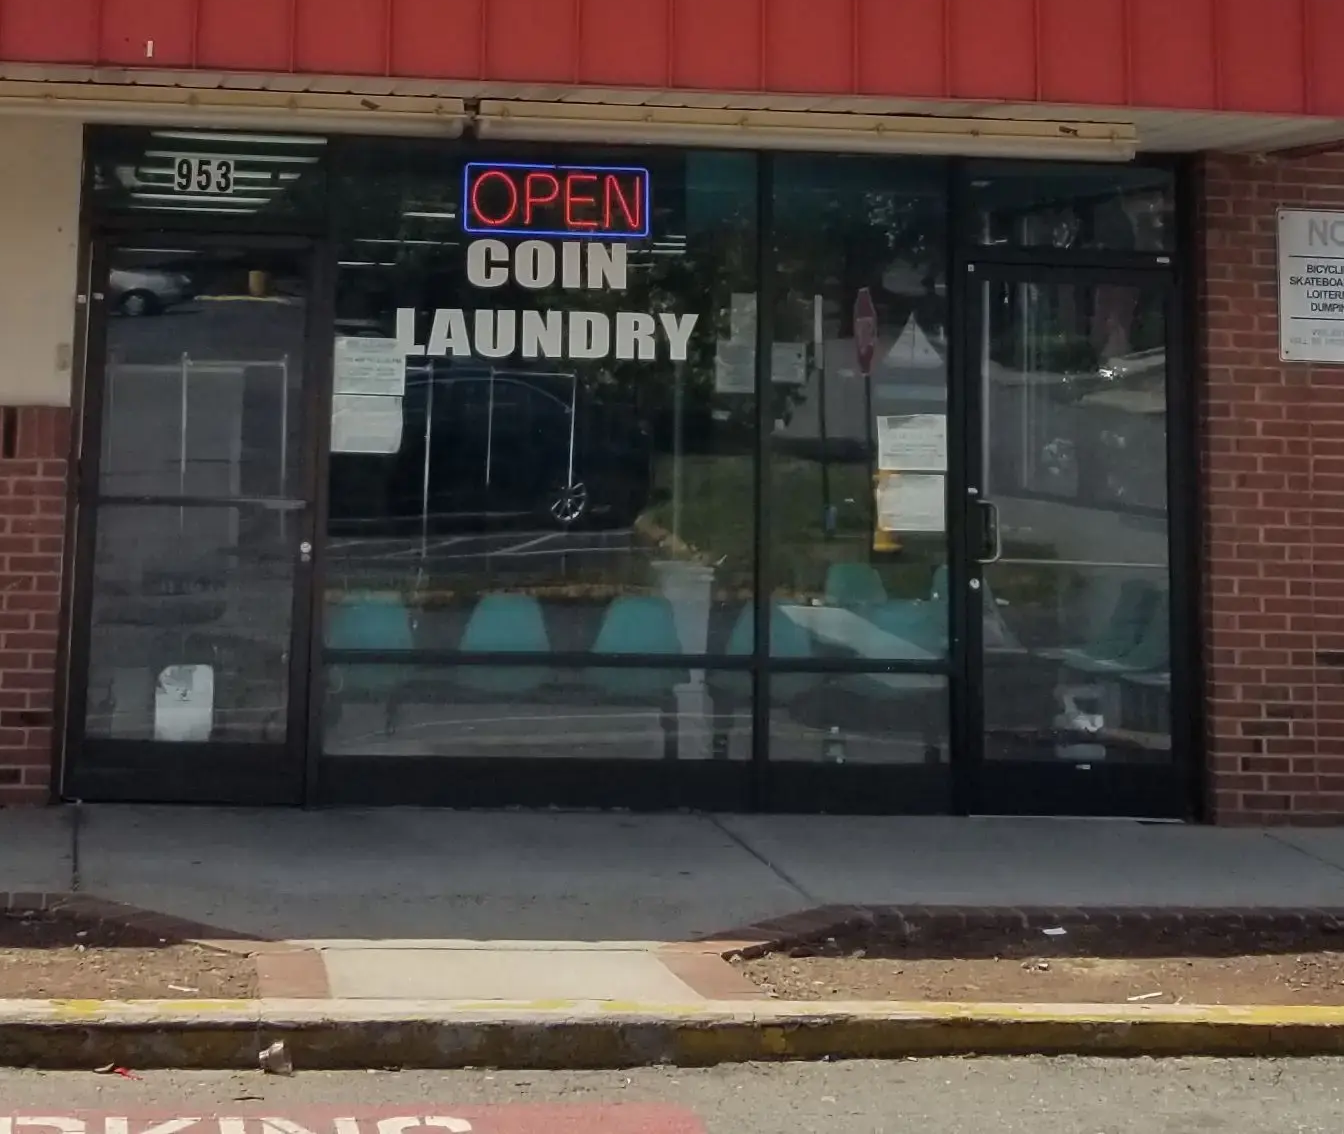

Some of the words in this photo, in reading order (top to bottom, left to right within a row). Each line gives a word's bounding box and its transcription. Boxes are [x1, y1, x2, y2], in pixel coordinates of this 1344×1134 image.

[176, 158, 232, 193] 953
[472, 170, 641, 229] OPEN
[467, 239, 627, 290] COIN
[396, 307, 700, 360] LAUNDRY
